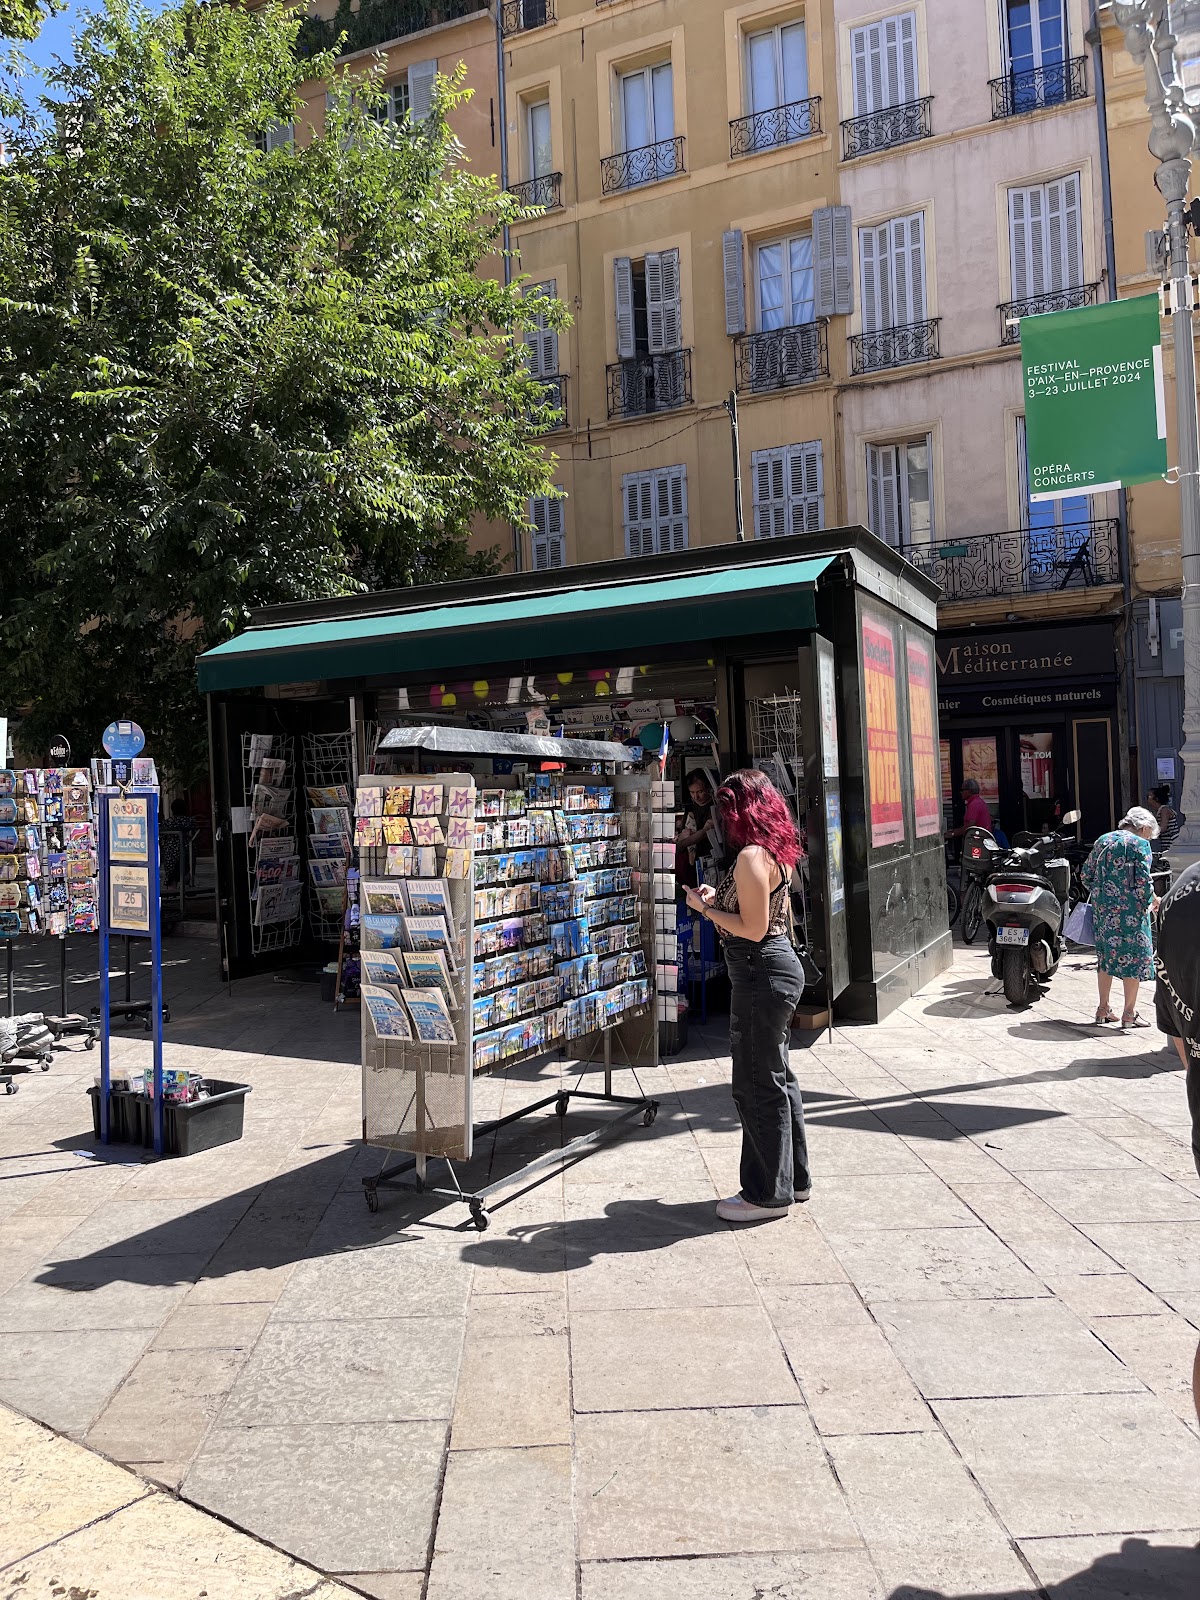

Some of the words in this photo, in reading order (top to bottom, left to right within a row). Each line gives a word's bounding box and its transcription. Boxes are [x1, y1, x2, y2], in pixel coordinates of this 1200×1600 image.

[1027, 359, 1080, 375] FESTIVAL
[1062, 378, 1108, 393] JUILLET
[1112, 373, 1141, 385] 2024
[1033, 463, 1071, 476] OPÉRA
[1034, 471, 1095, 487] CONCERTS
[982, 693, 1052, 708] Cosmétiques
[1055, 689, 1102, 702] naturels
[127, 824, 134, 836] 2
[416, 882, 442, 892] PROVENCE
[124, 893, 136, 905] 26
[415, 919, 442, 929] PROVENCE
